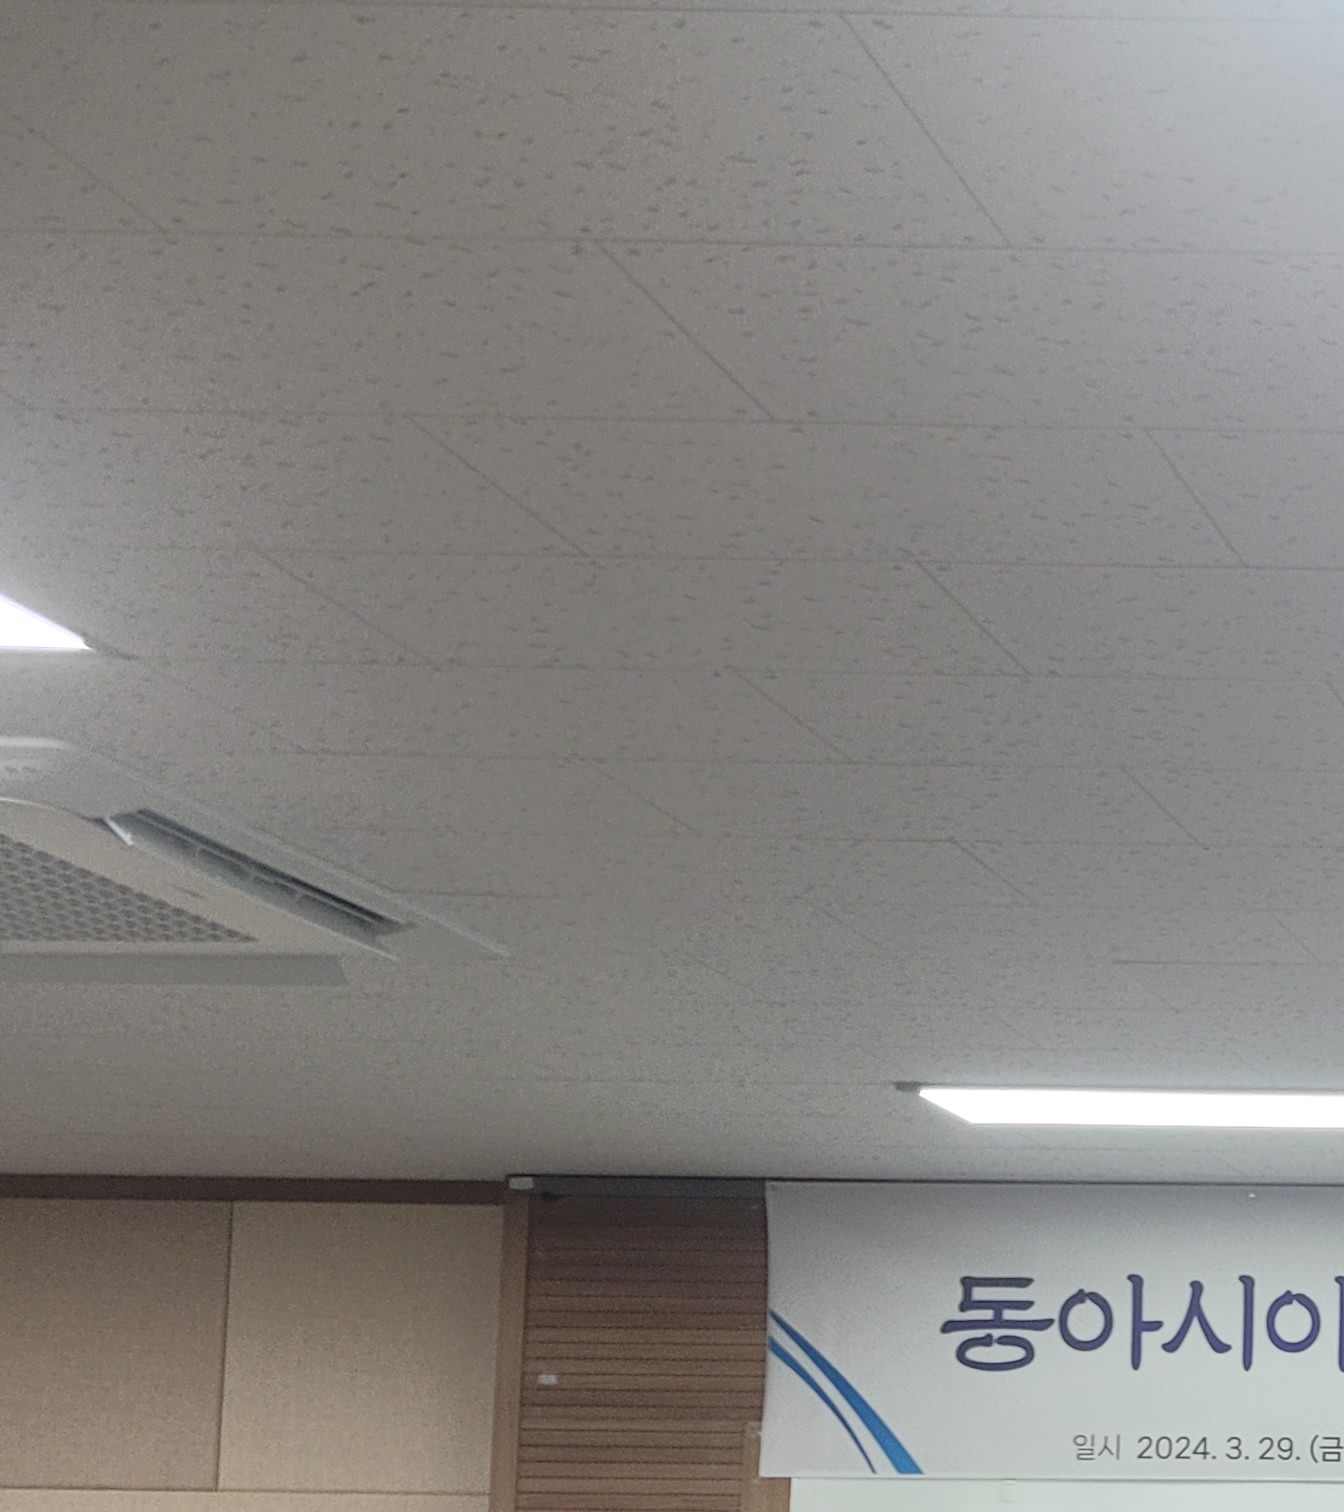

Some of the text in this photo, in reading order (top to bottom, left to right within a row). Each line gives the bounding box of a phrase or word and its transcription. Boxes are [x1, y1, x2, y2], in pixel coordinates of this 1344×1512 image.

[1073, 1435, 1120, 1460] 일시
[1137, 1436, 1216, 1459] 2024.
[1226, 1437, 1249, 1460] 3.
[1259, 1437, 1300, 1460] 29.
